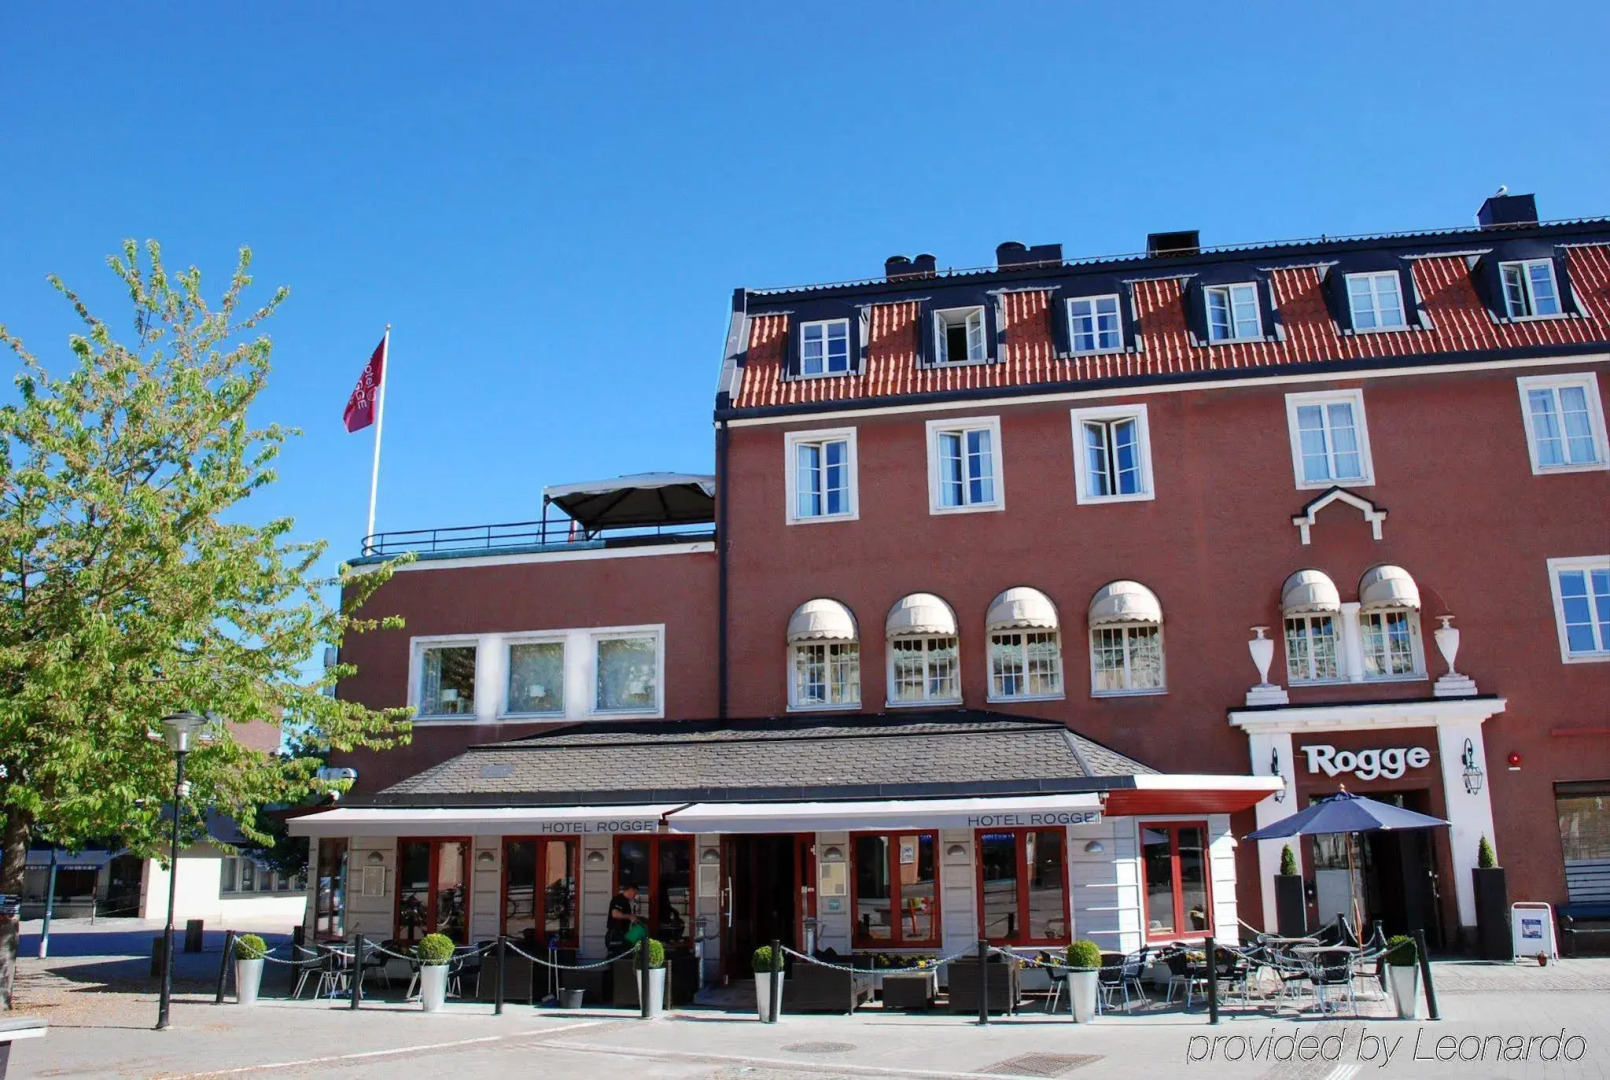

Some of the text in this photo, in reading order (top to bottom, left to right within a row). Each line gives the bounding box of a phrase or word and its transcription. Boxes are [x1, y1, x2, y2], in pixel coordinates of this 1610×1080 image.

[1300, 744, 1431, 781] Rogge
[541, 820, 654, 833] HOTEL ROGGE
[967, 811, 1095, 827] HOTEL ROGGE
